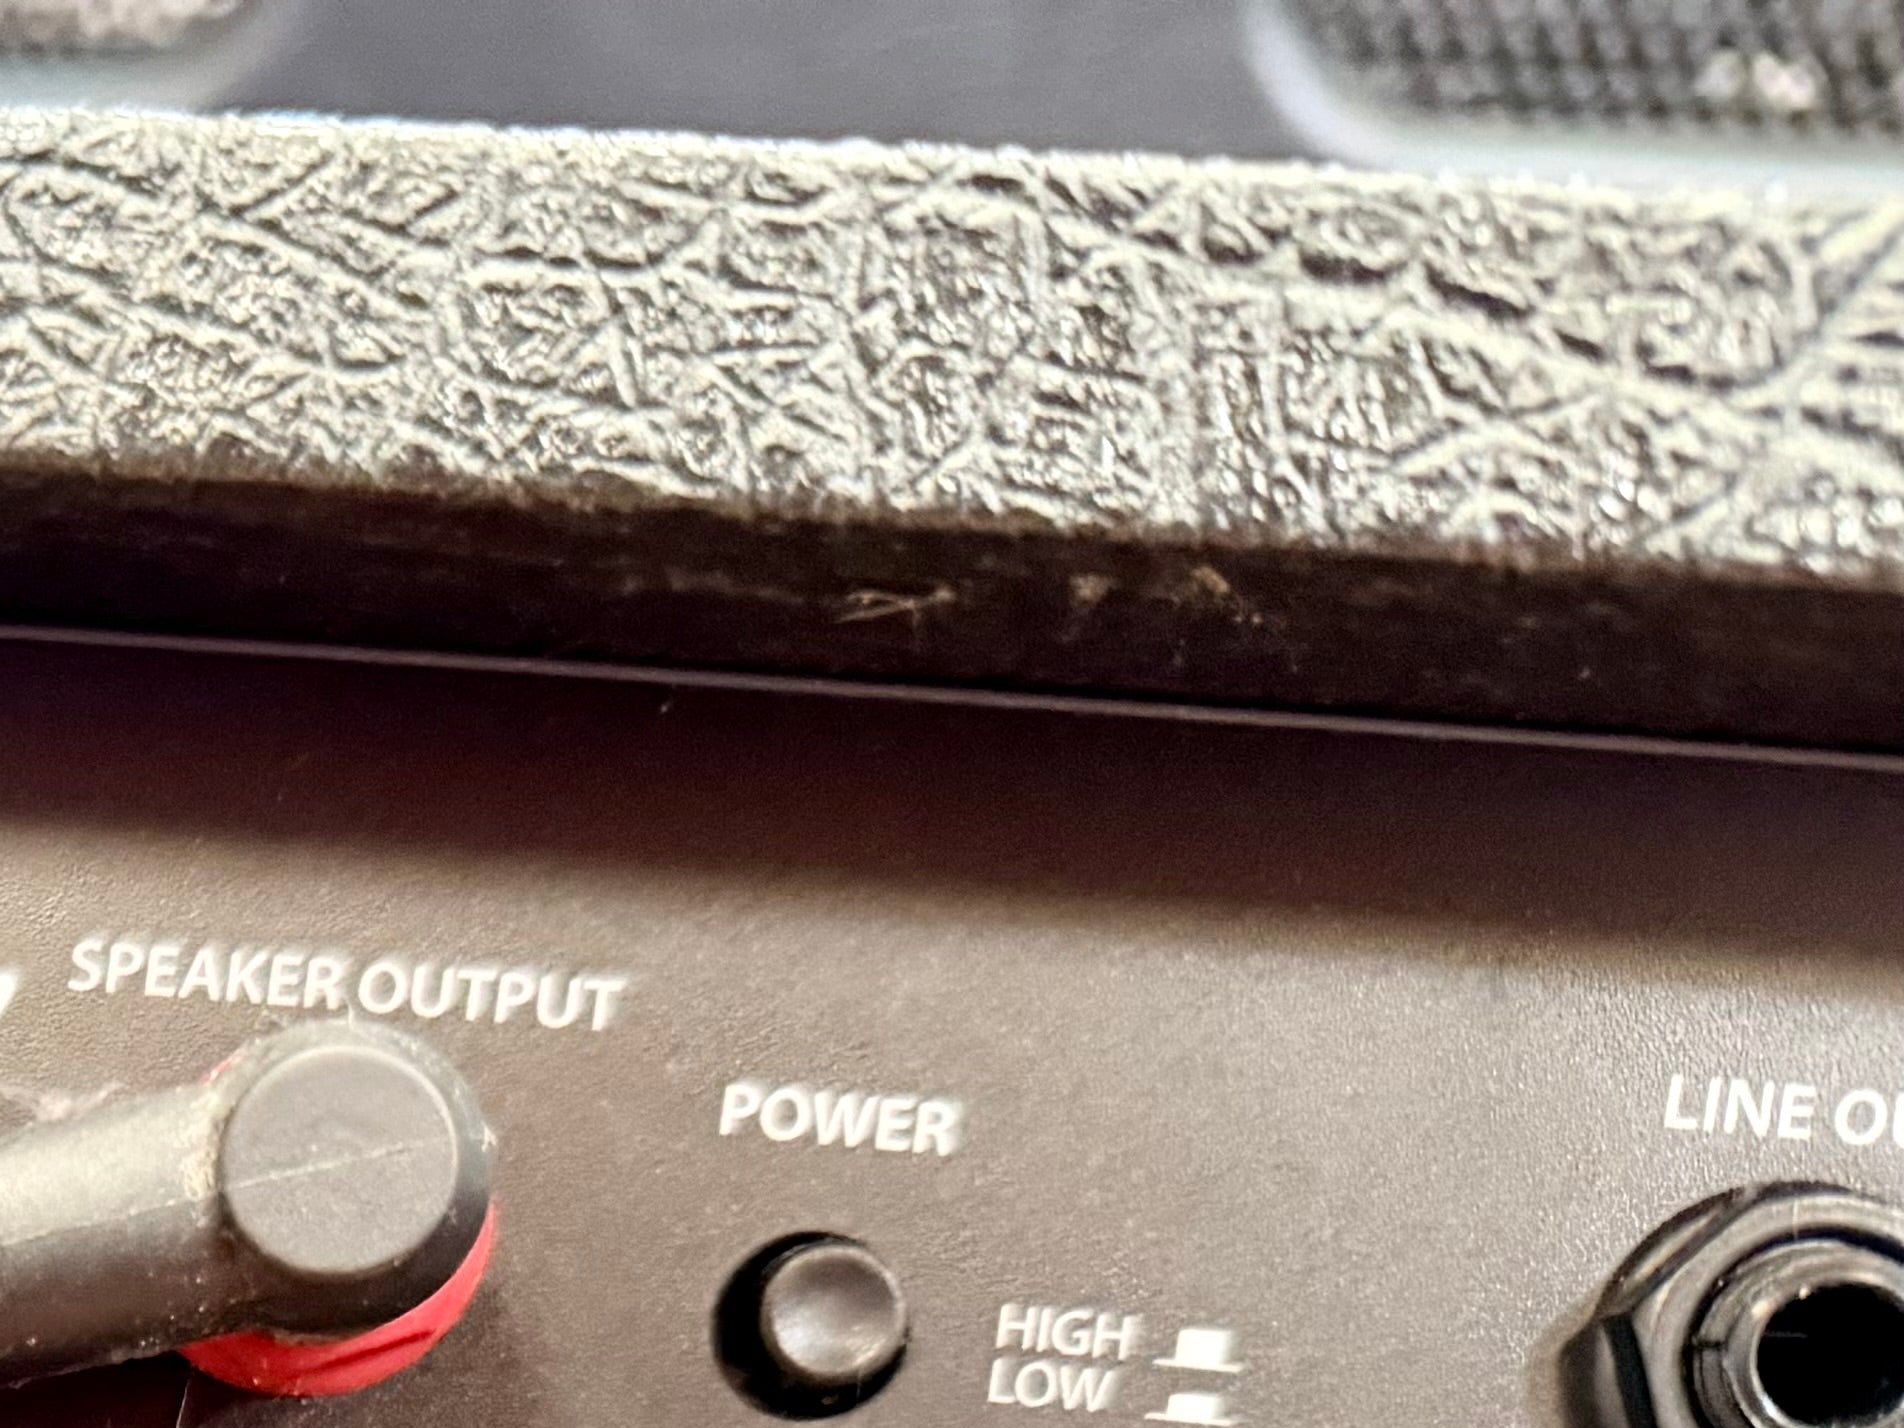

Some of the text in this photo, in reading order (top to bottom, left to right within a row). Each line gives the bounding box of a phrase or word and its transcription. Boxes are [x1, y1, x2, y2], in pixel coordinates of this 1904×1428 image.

[68, 937, 626, 1031] SPEAKER OUTPUT
[718, 1081, 963, 1156] POWER
[1664, 1074, 1904, 1149] LINE O
[994, 1303, 1137, 1362] HIGH
[987, 1357, 1120, 1413] LOW
